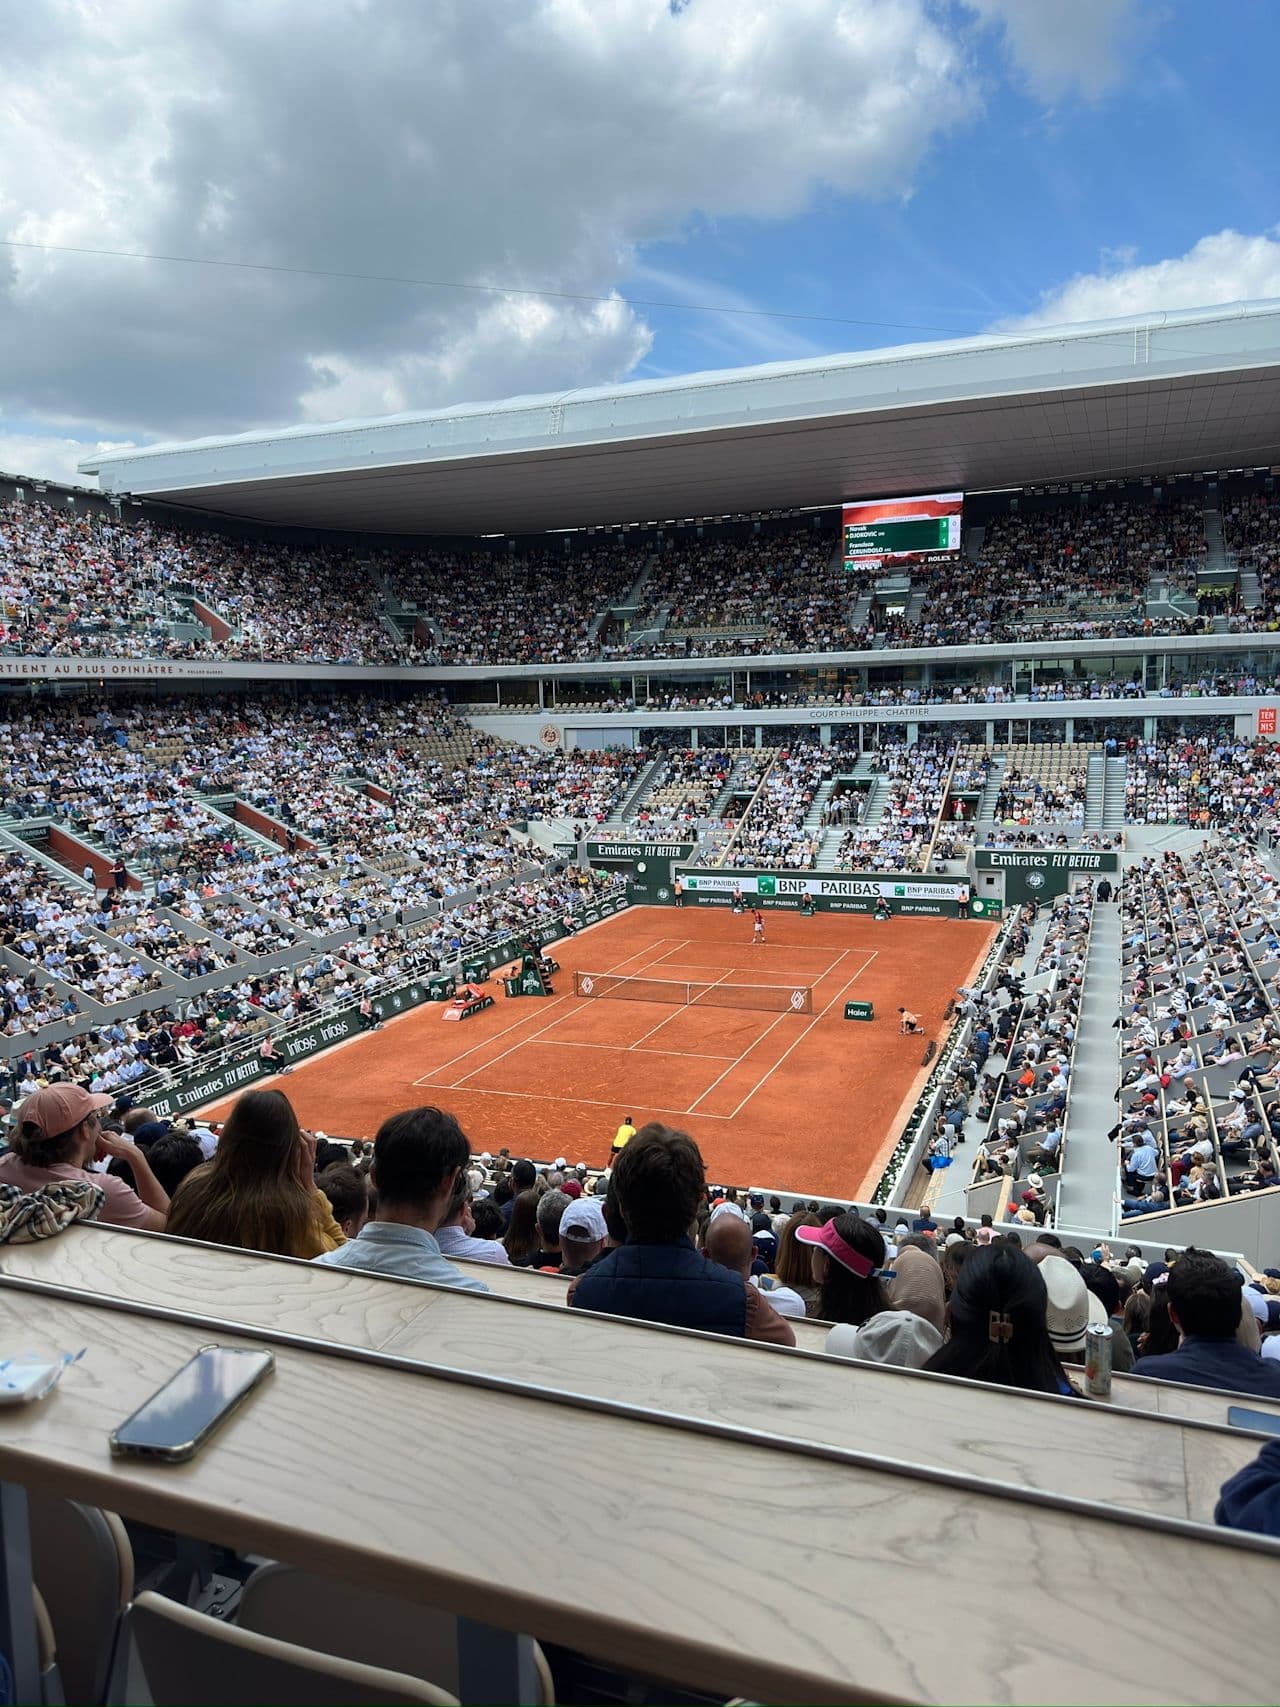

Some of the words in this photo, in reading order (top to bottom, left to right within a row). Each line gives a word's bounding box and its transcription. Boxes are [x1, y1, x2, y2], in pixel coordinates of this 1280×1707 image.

[849, 531, 878, 539] DJOKOVIC
[54, 664, 70, 673] AU
[77, 665, 106, 674] PLUS
[111, 663, 173, 674] OPINIÂTRE
[809, 710, 838, 719] COURT
[840, 709, 879, 717] PHILIPPE
[885, 707, 929, 716] CHATRIER
[1261, 711, 1275, 720] TEN
[1260, 722, 1274, 732] NIS
[598, 844, 642, 857] Emirates
[644, 846, 657, 857] FLY
[656, 846, 681, 857] BETTER
[990, 853, 1048, 867] Emirates
[1052, 854, 1069, 867] FLY
[1068, 855, 1101, 868] BETTER
[779, 880, 807, 893] BNP
[821, 881, 881, 896] PARIBAS
[924, 887, 955, 895] PARIBAS
[914, 905, 940, 913] PARIBAS
[847, 1008, 868, 1017] Haier
[286, 1034, 318, 1057] Infosys
[319, 1020, 349, 1041] Infosys
[175, 1078, 224, 1107] Emirates
[224, 1069, 237, 1087] FLY
[236, 1059, 260, 1081] BETTER
